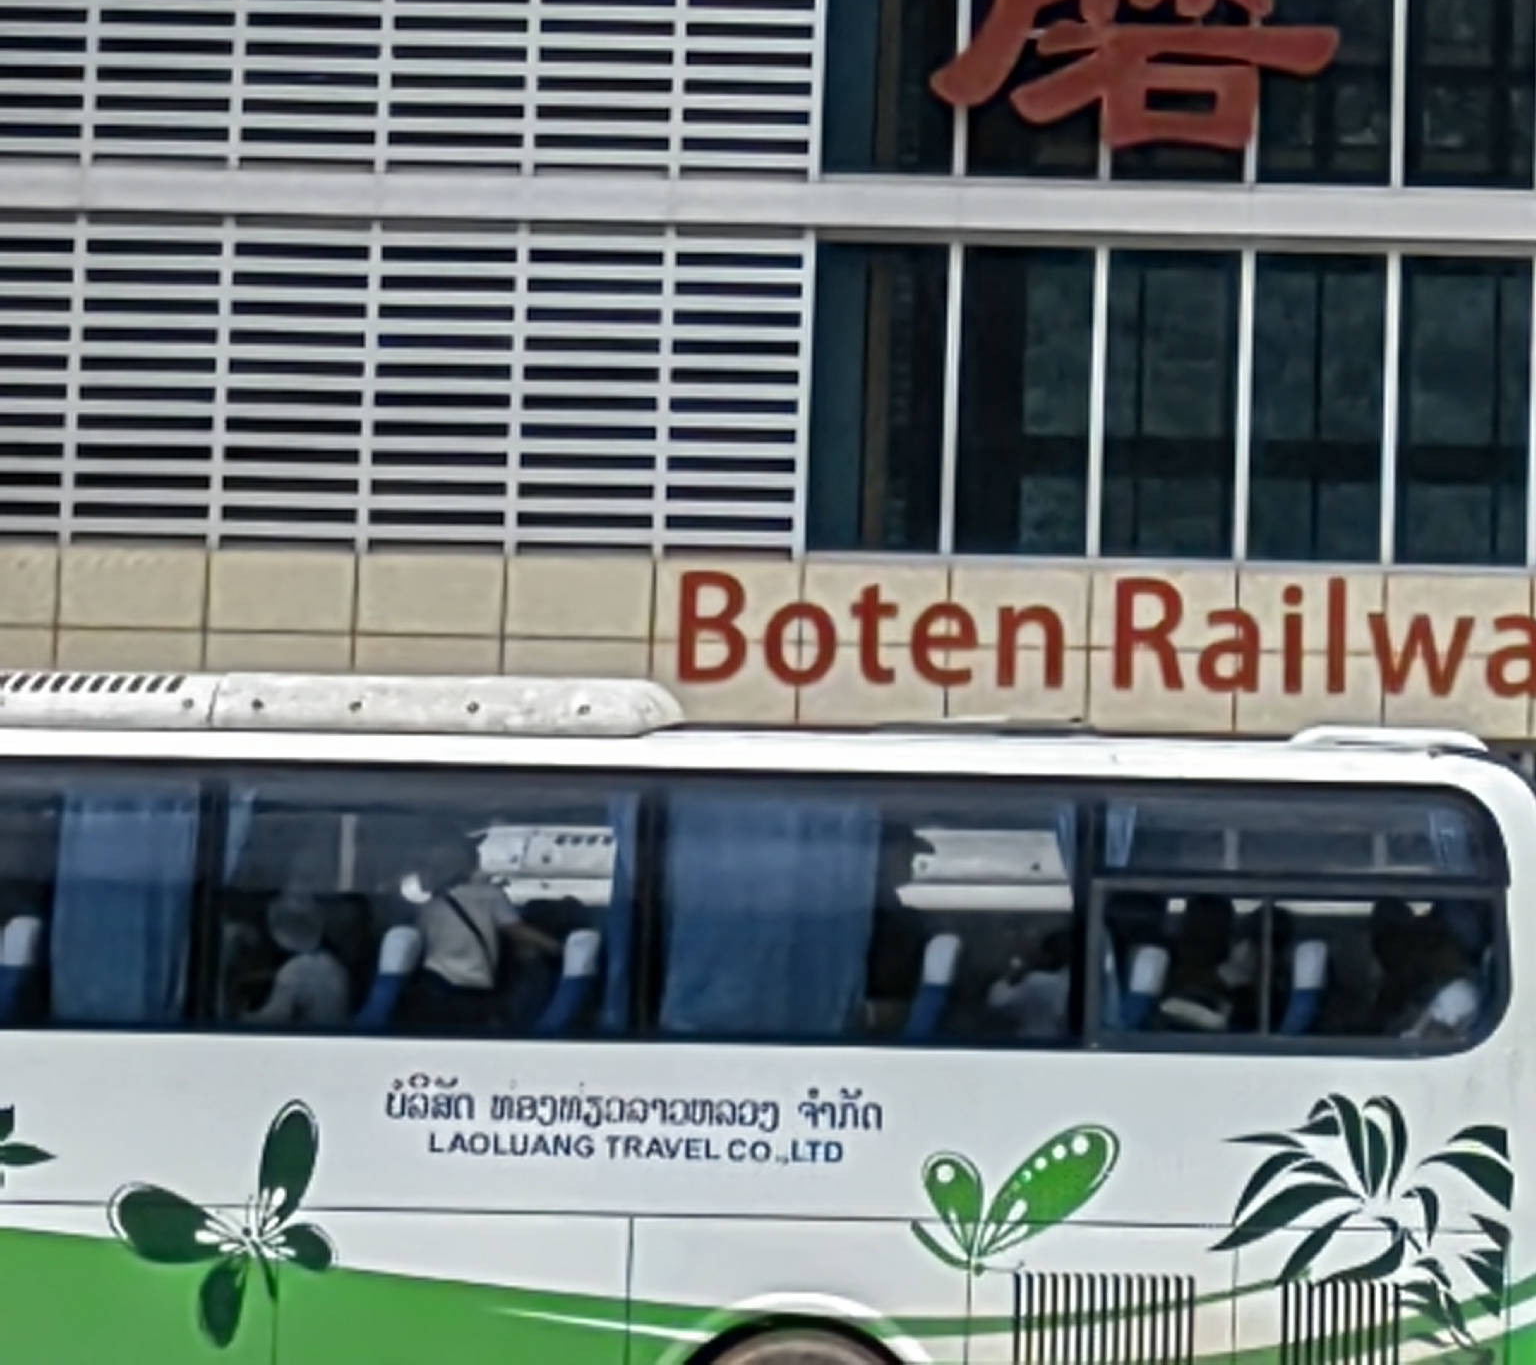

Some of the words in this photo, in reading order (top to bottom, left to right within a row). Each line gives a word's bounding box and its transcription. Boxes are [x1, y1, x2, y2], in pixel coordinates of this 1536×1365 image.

[675, 568, 1064, 688] Boten
[428, 1131, 596, 1159] LAOLUANG
[605, 1134, 721, 1160] TRAVEL
